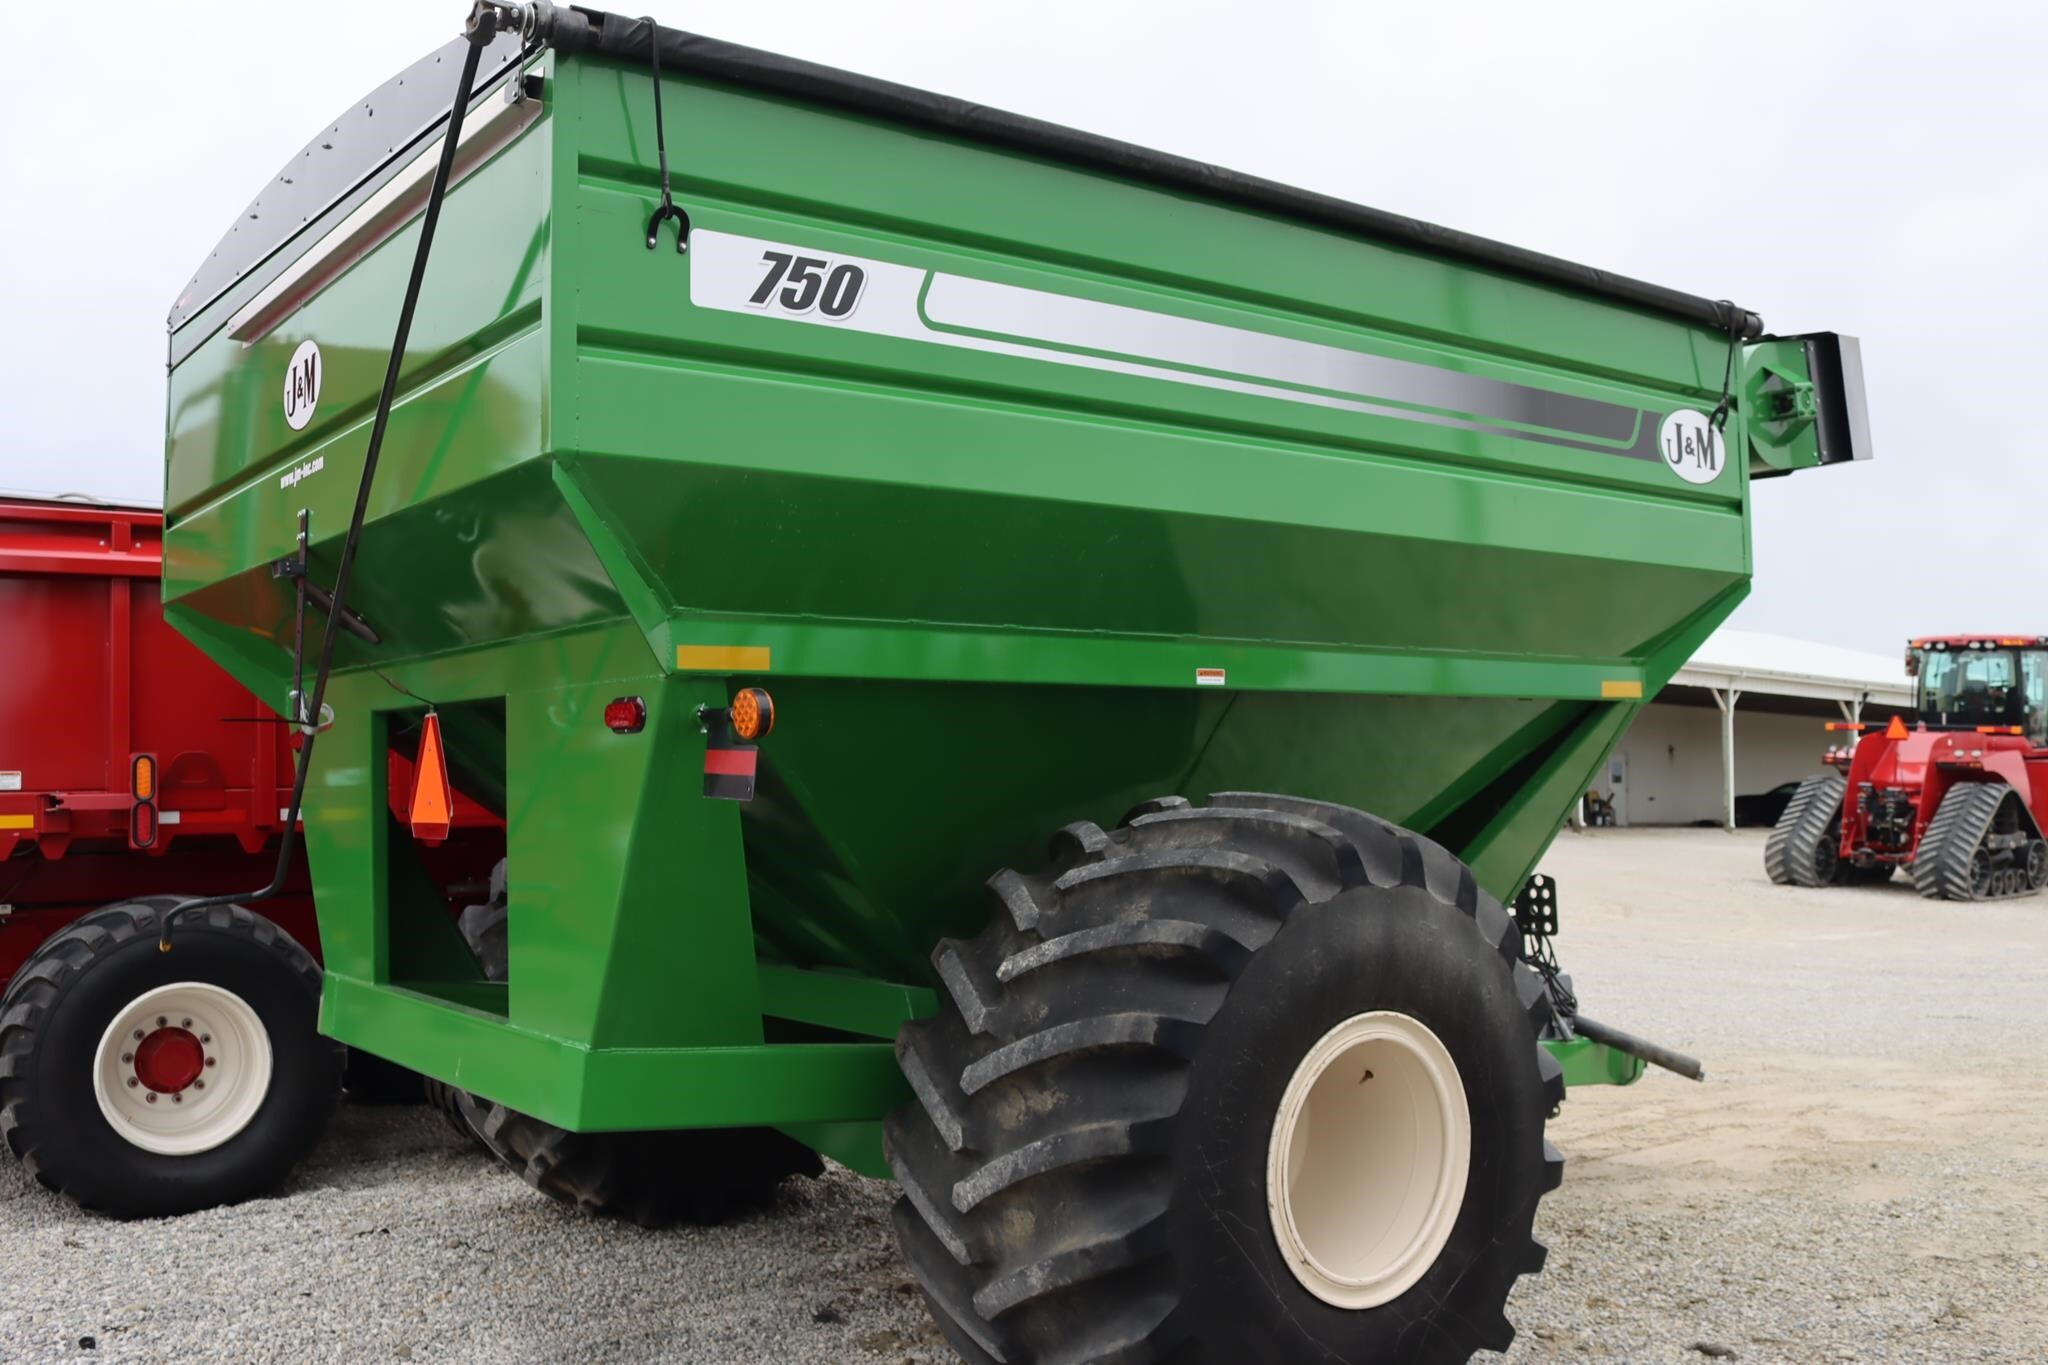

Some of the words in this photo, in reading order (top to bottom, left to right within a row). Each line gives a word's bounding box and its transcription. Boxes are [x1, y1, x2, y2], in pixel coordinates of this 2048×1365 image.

[747, 250, 867, 318] 750
[287, 352, 316, 417] J&M
[1666, 423, 1716, 471] J&M
